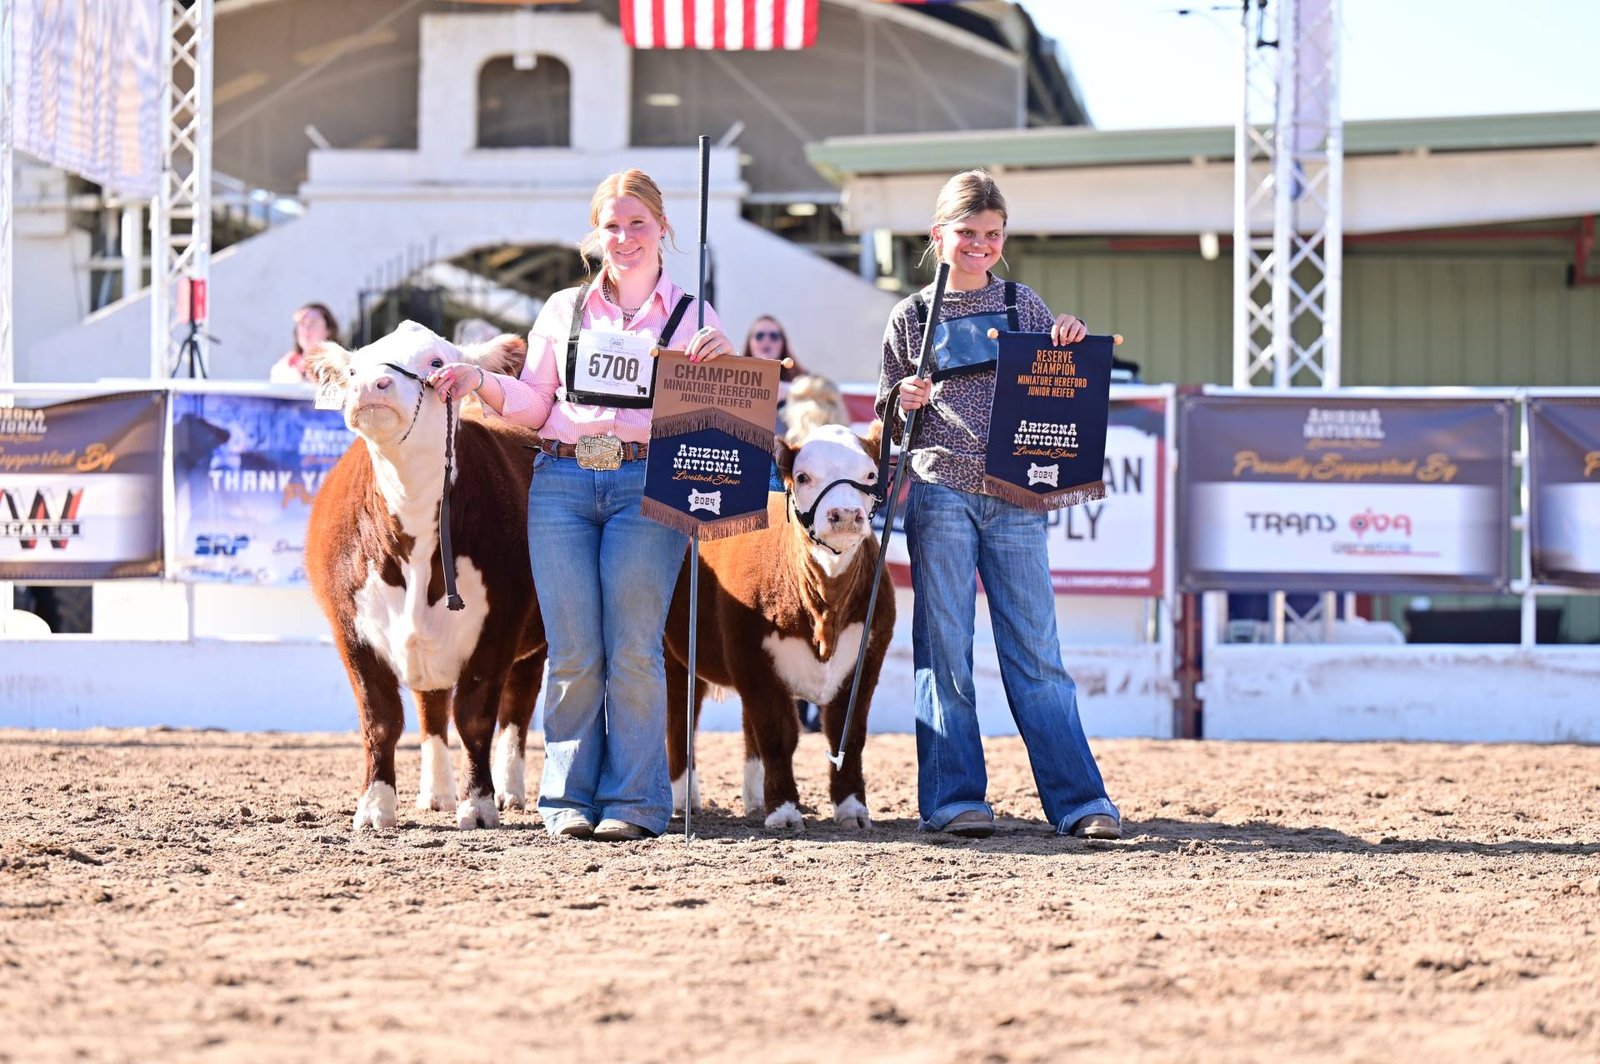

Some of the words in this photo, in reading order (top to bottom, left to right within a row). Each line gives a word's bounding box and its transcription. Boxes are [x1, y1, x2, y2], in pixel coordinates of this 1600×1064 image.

[1036, 349, 1073, 364] RESERVE
[588, 352, 640, 383] 5700
[674, 363, 763, 387] CHAMPION
[1031, 361, 1076, 377] CHAMPION
[1017, 374, 1053, 386] MINIATURE
[1054, 376, 1088, 388] HEREFORD
[663, 379, 718, 395] MINIATURE
[719, 383, 771, 401] HEREFORD
[1027, 386, 1051, 397] JUNIOR
[1051, 388, 1075, 398] HEIFER
[680, 392, 715, 405] JUNIOR
[717, 397, 752, 409] HEIFER
[1018, 420, 1077, 436] ARIZONA
[1013, 433, 1079, 448] NATIONAL
[76, 442, 117, 472] By
[677, 444, 740, 462] ARIZONA
[1012, 445, 1052, 456] Livestock
[1050, 448, 1078, 458] Show
[673, 457, 742, 475] NATIONAL
[1233, 451, 1312, 480] Proudly
[1311, 453, 1417, 481] Supported
[1416, 453, 1457, 481] By
[208, 469, 292, 492] THANK
[672, 469, 714, 483] Livestock
[712, 474, 741, 485] Show
[1033, 470, 1053, 479] 2024
[694, 496, 715, 506] 2024
[195, 534, 250, 555] SRP
